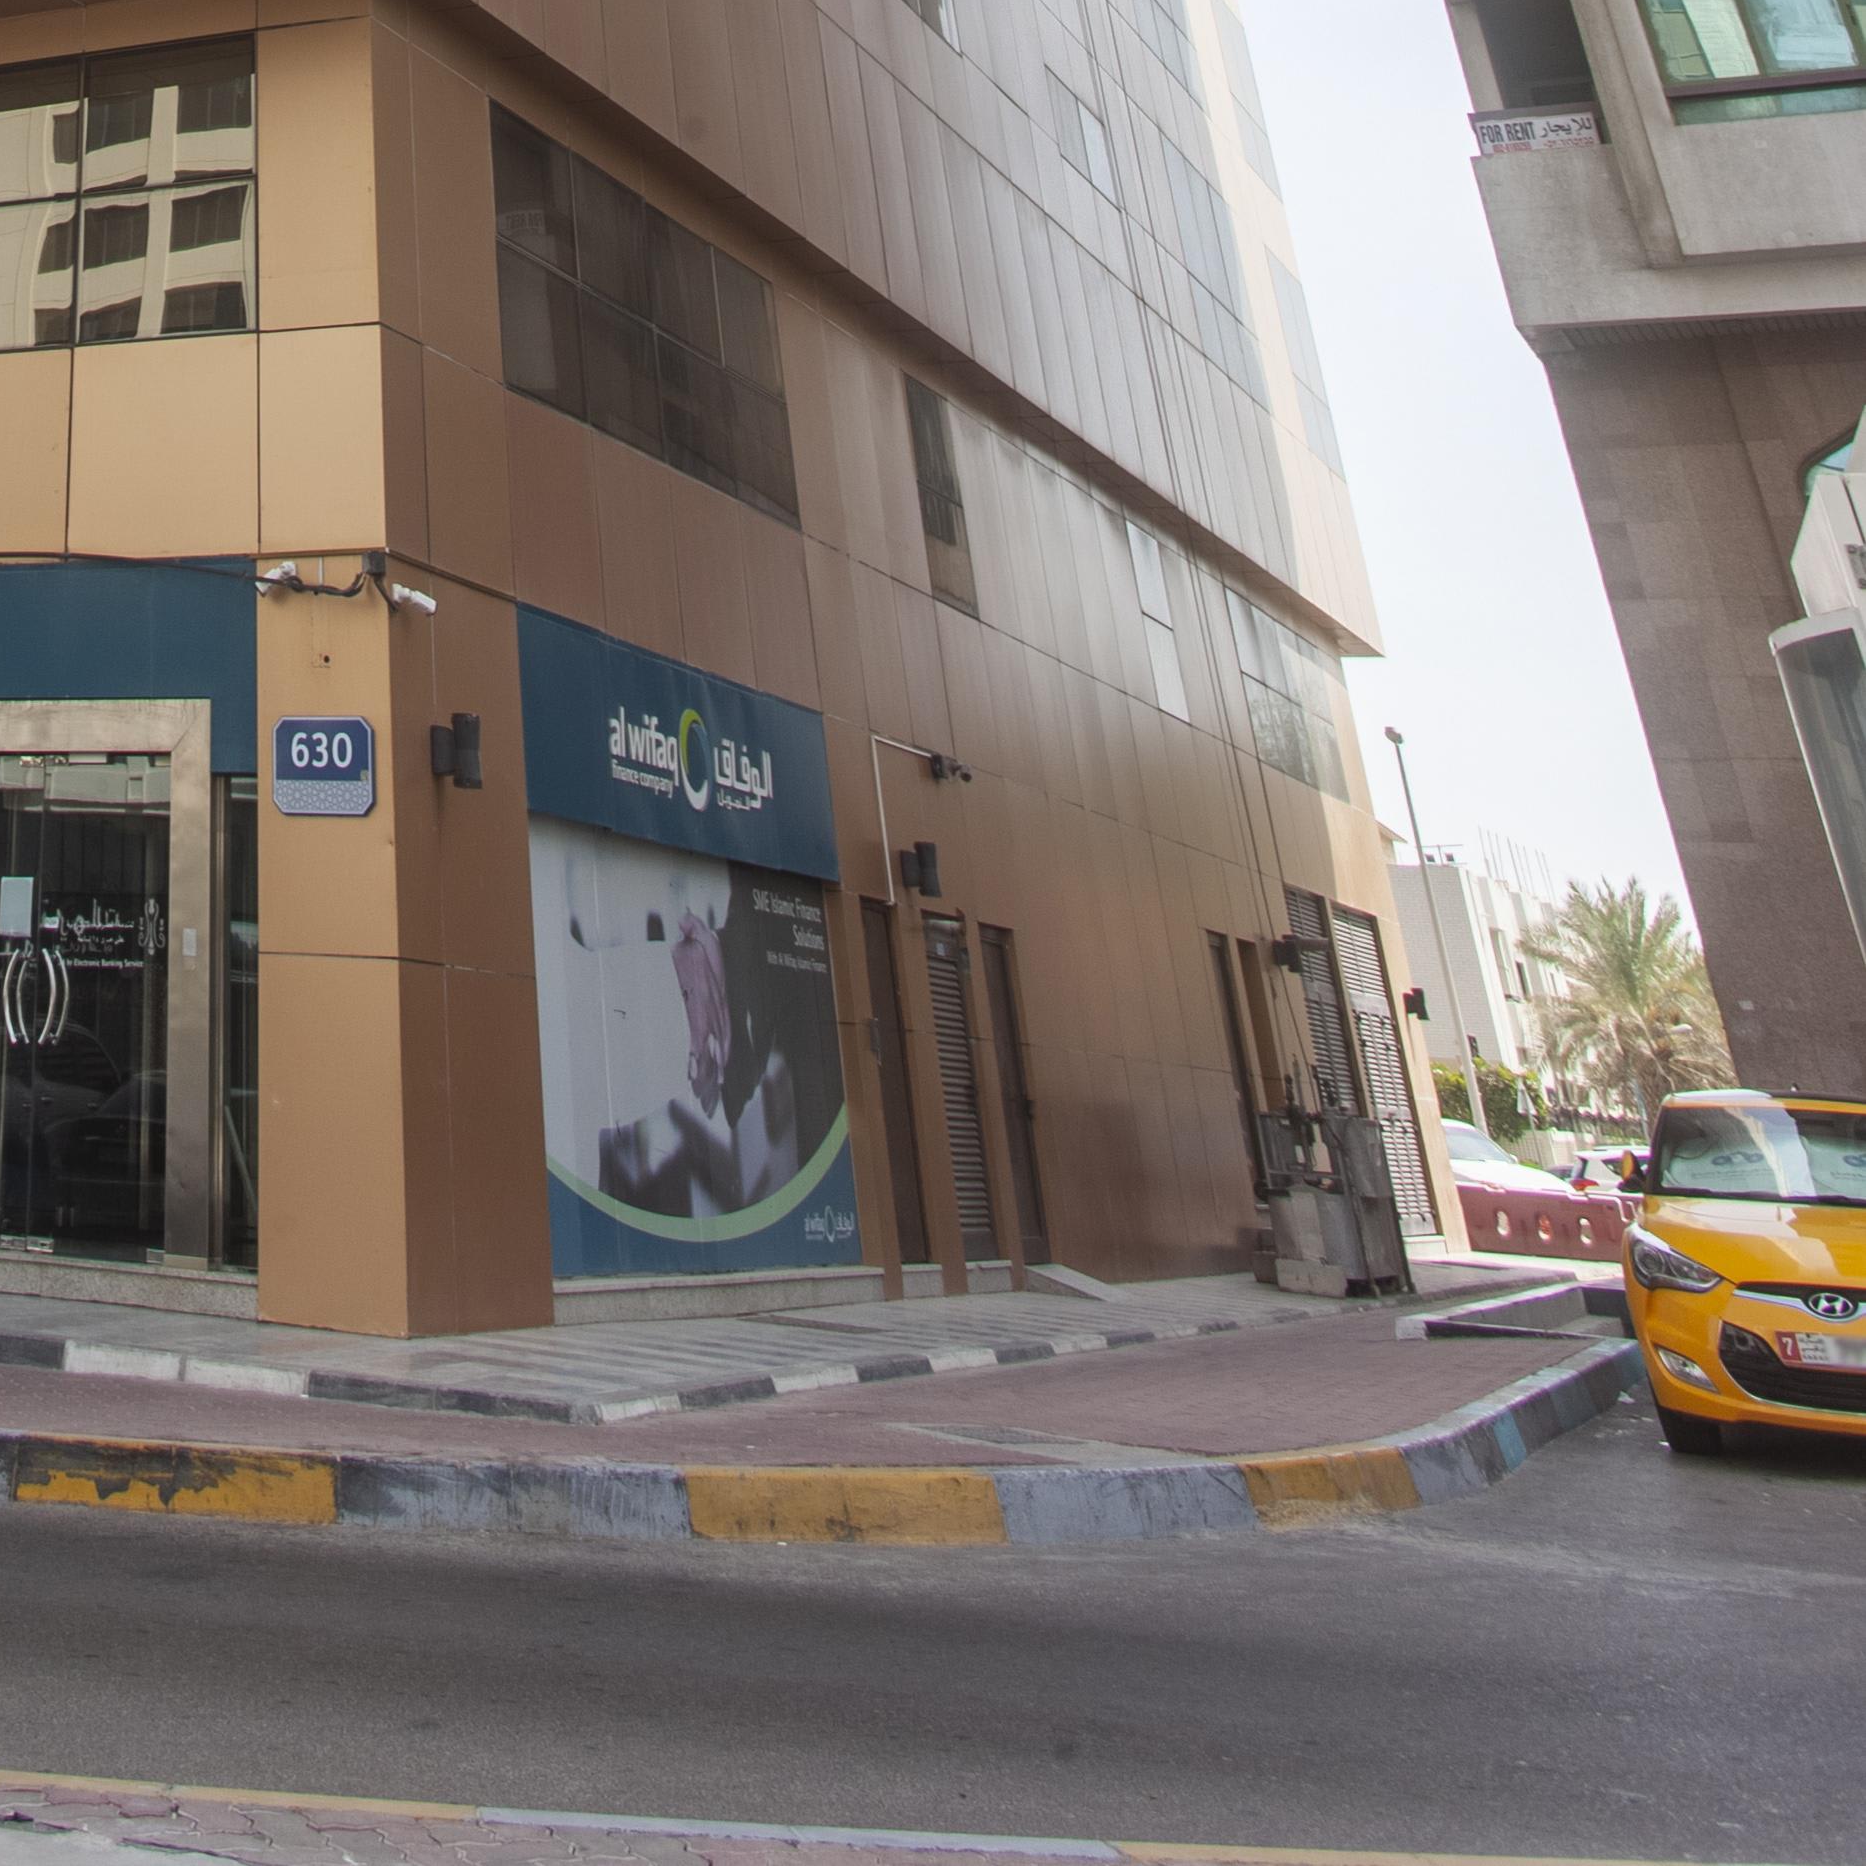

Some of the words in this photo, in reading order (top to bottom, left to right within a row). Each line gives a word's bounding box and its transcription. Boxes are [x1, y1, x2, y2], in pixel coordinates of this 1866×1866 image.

[1479, 125, 1503, 144] FOR
[1503, 121, 1536, 142] RENT
[291, 732, 353, 768] 630
[609, 706, 626, 758] al
[627, 714, 680, 787] wifaq
[611, 759, 639, 784] finance
[639, 773, 673, 799] company
[714, 738, 773, 809] الوفاق
[753, 888, 770, 913] SME
[770, 892, 795, 918] Islamic
[795, 897, 822, 923] Finance
[793, 924, 825, 950] Solutions
[1781, 1337, 1794, 1356] 7
